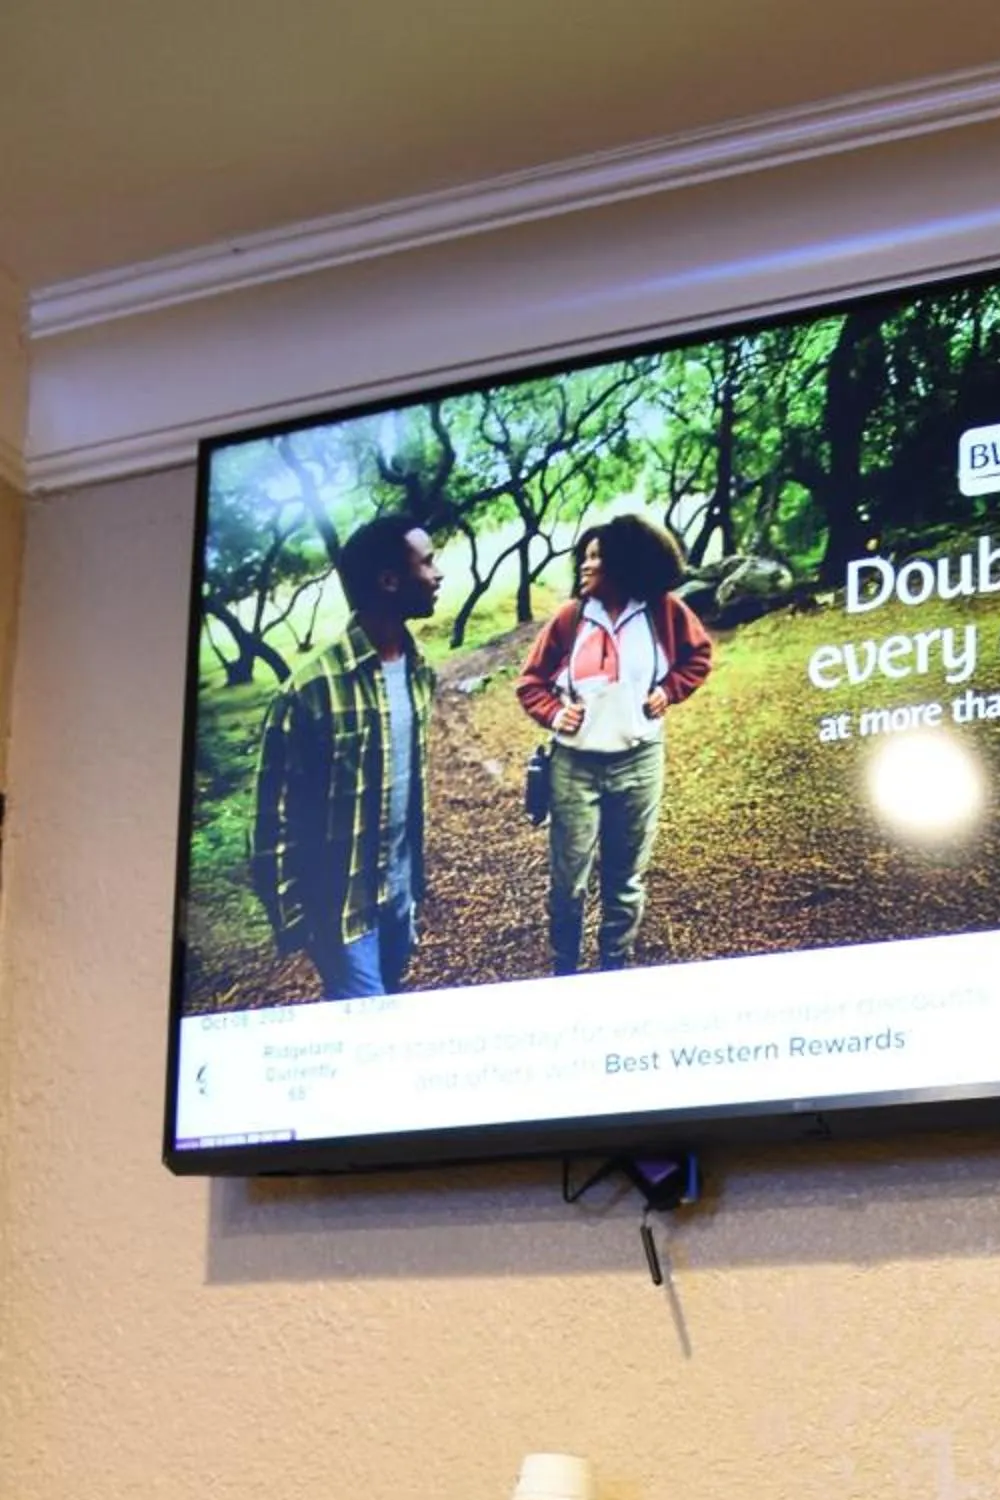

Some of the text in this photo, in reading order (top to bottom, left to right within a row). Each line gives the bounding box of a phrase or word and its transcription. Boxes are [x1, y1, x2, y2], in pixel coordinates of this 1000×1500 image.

[806, 622, 978, 691] every
[818, 714, 849, 743] at
[859, 701, 942, 736] more
[605, 1051, 660, 1075] Best
[669, 1041, 779, 1068] Western
[788, 1024, 907, 1057] Rewards
